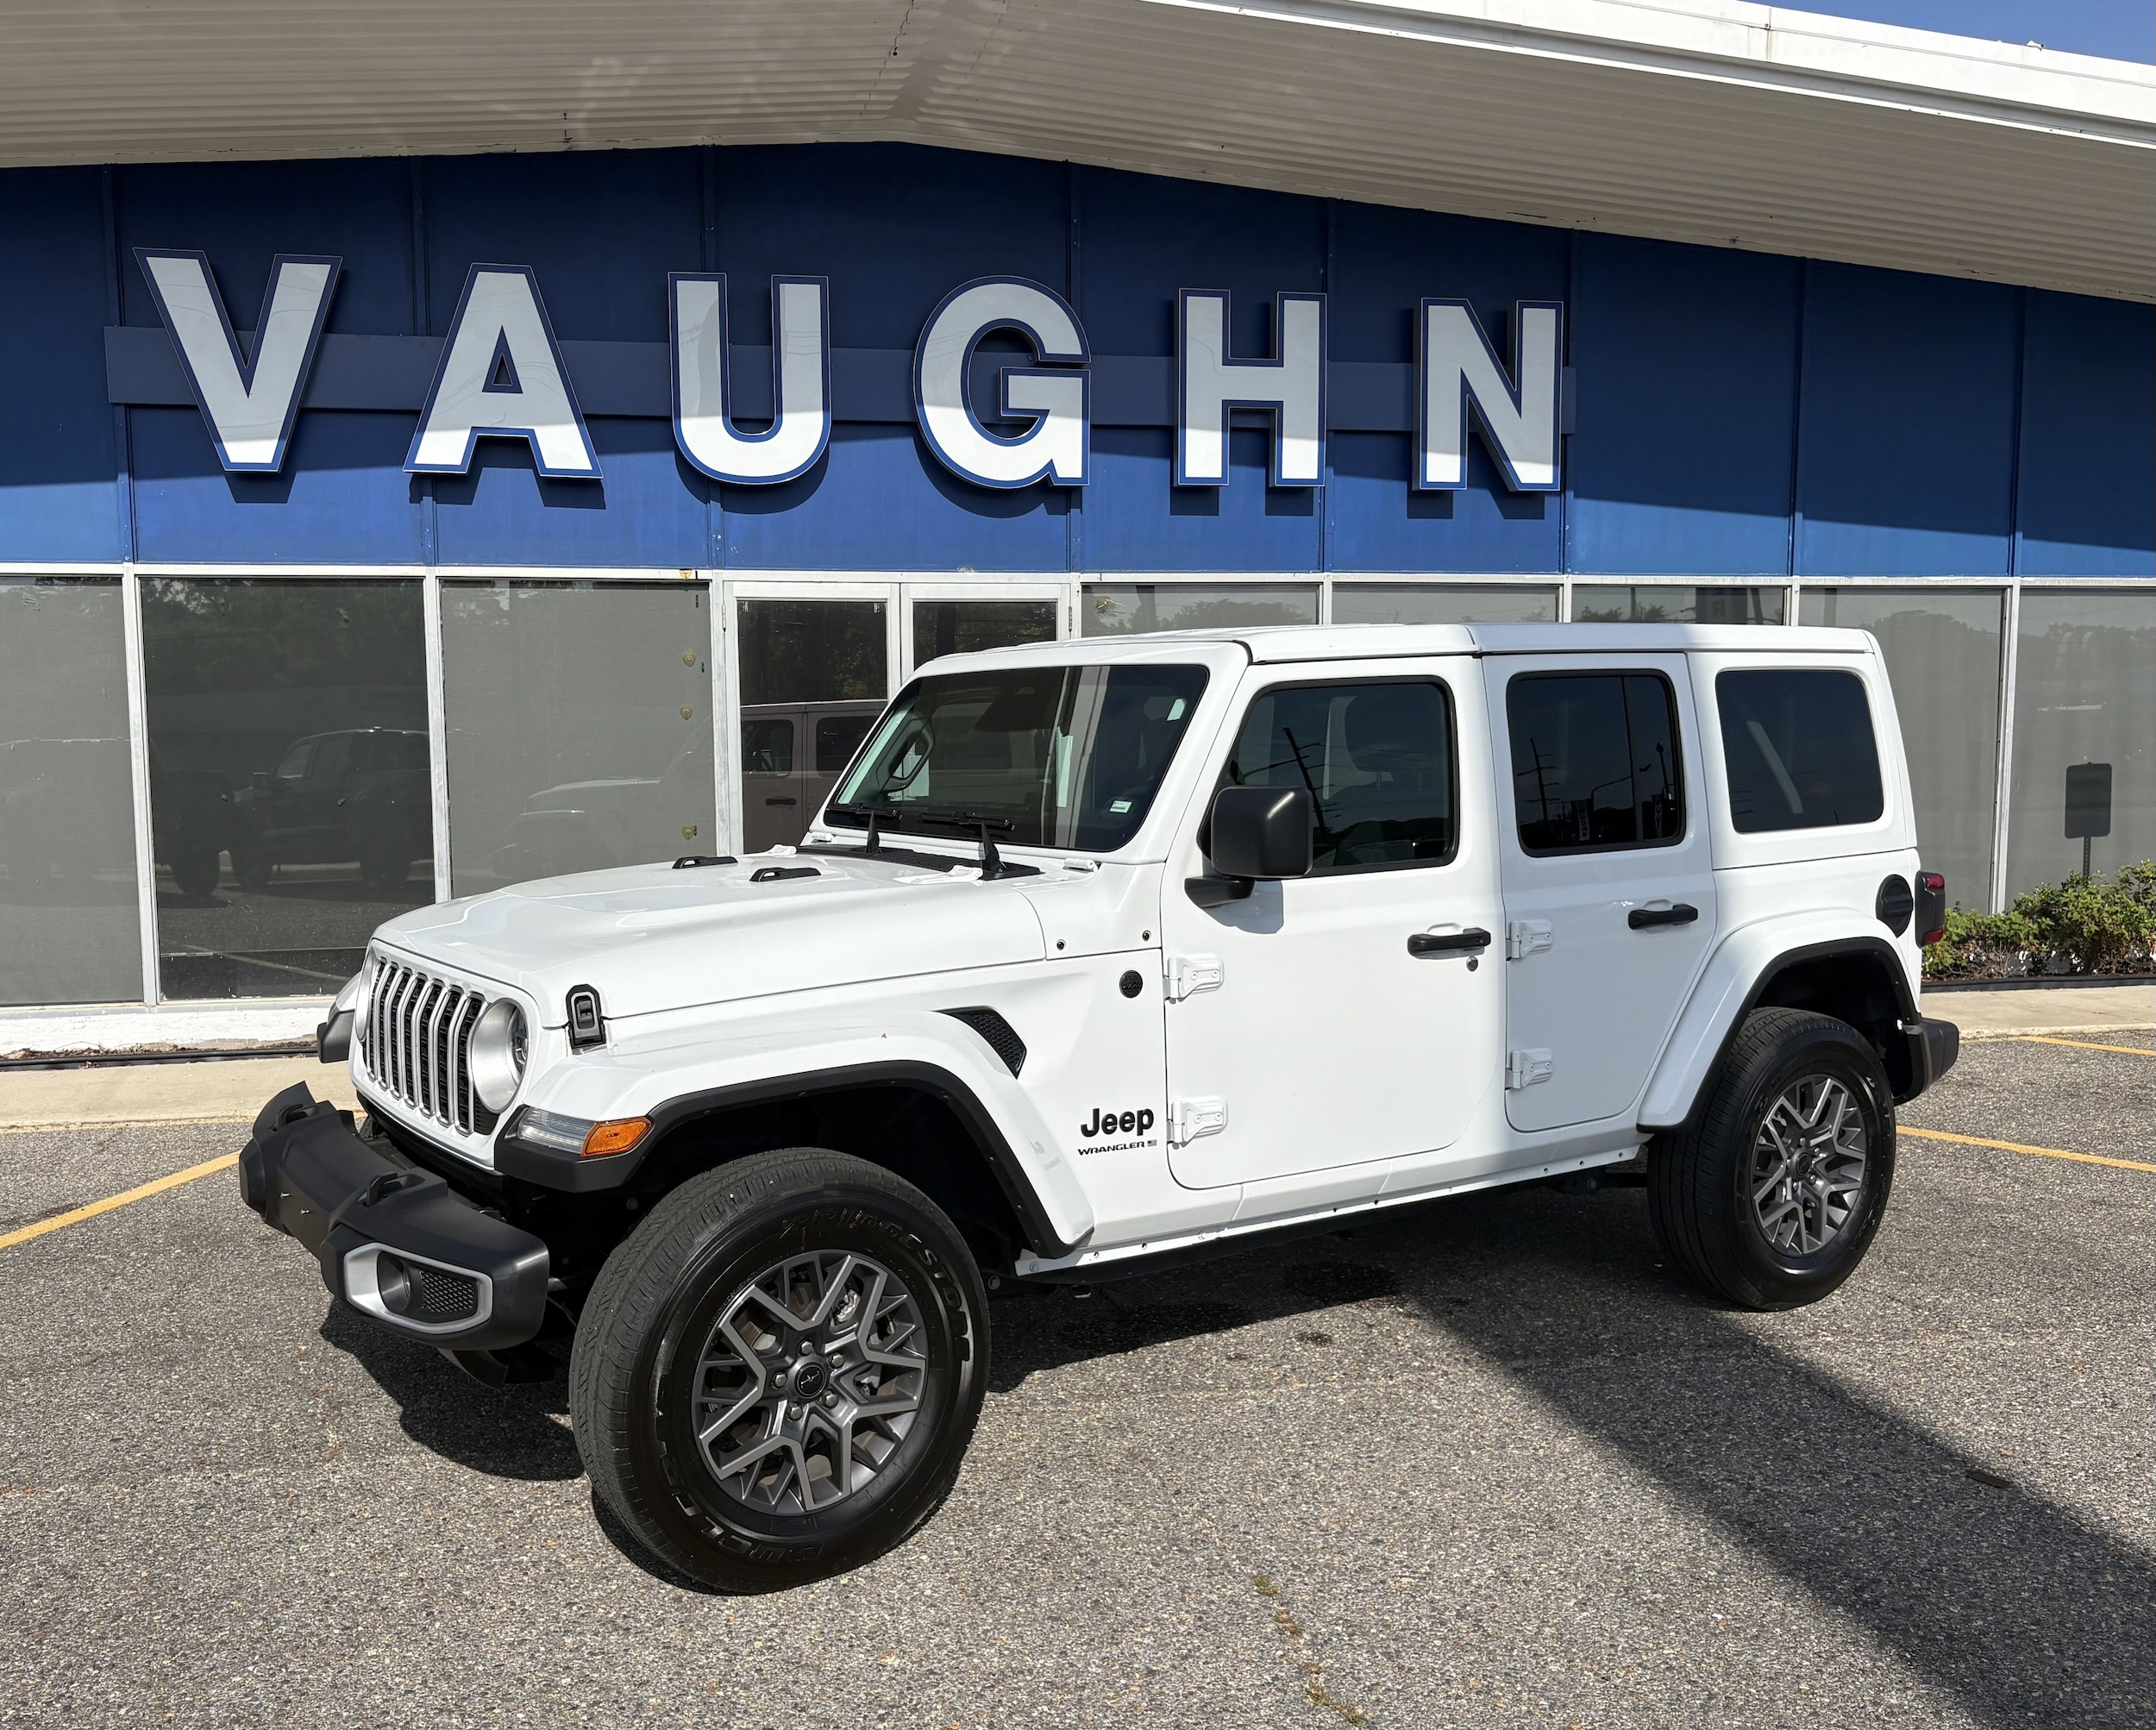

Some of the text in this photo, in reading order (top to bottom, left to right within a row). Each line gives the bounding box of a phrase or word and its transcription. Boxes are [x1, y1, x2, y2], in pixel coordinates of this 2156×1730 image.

[132, 248, 1564, 491] VAUGHN
[1080, 1107, 1155, 1138] Jeep
[1077, 1140, 1145, 1156] WRANGLER
